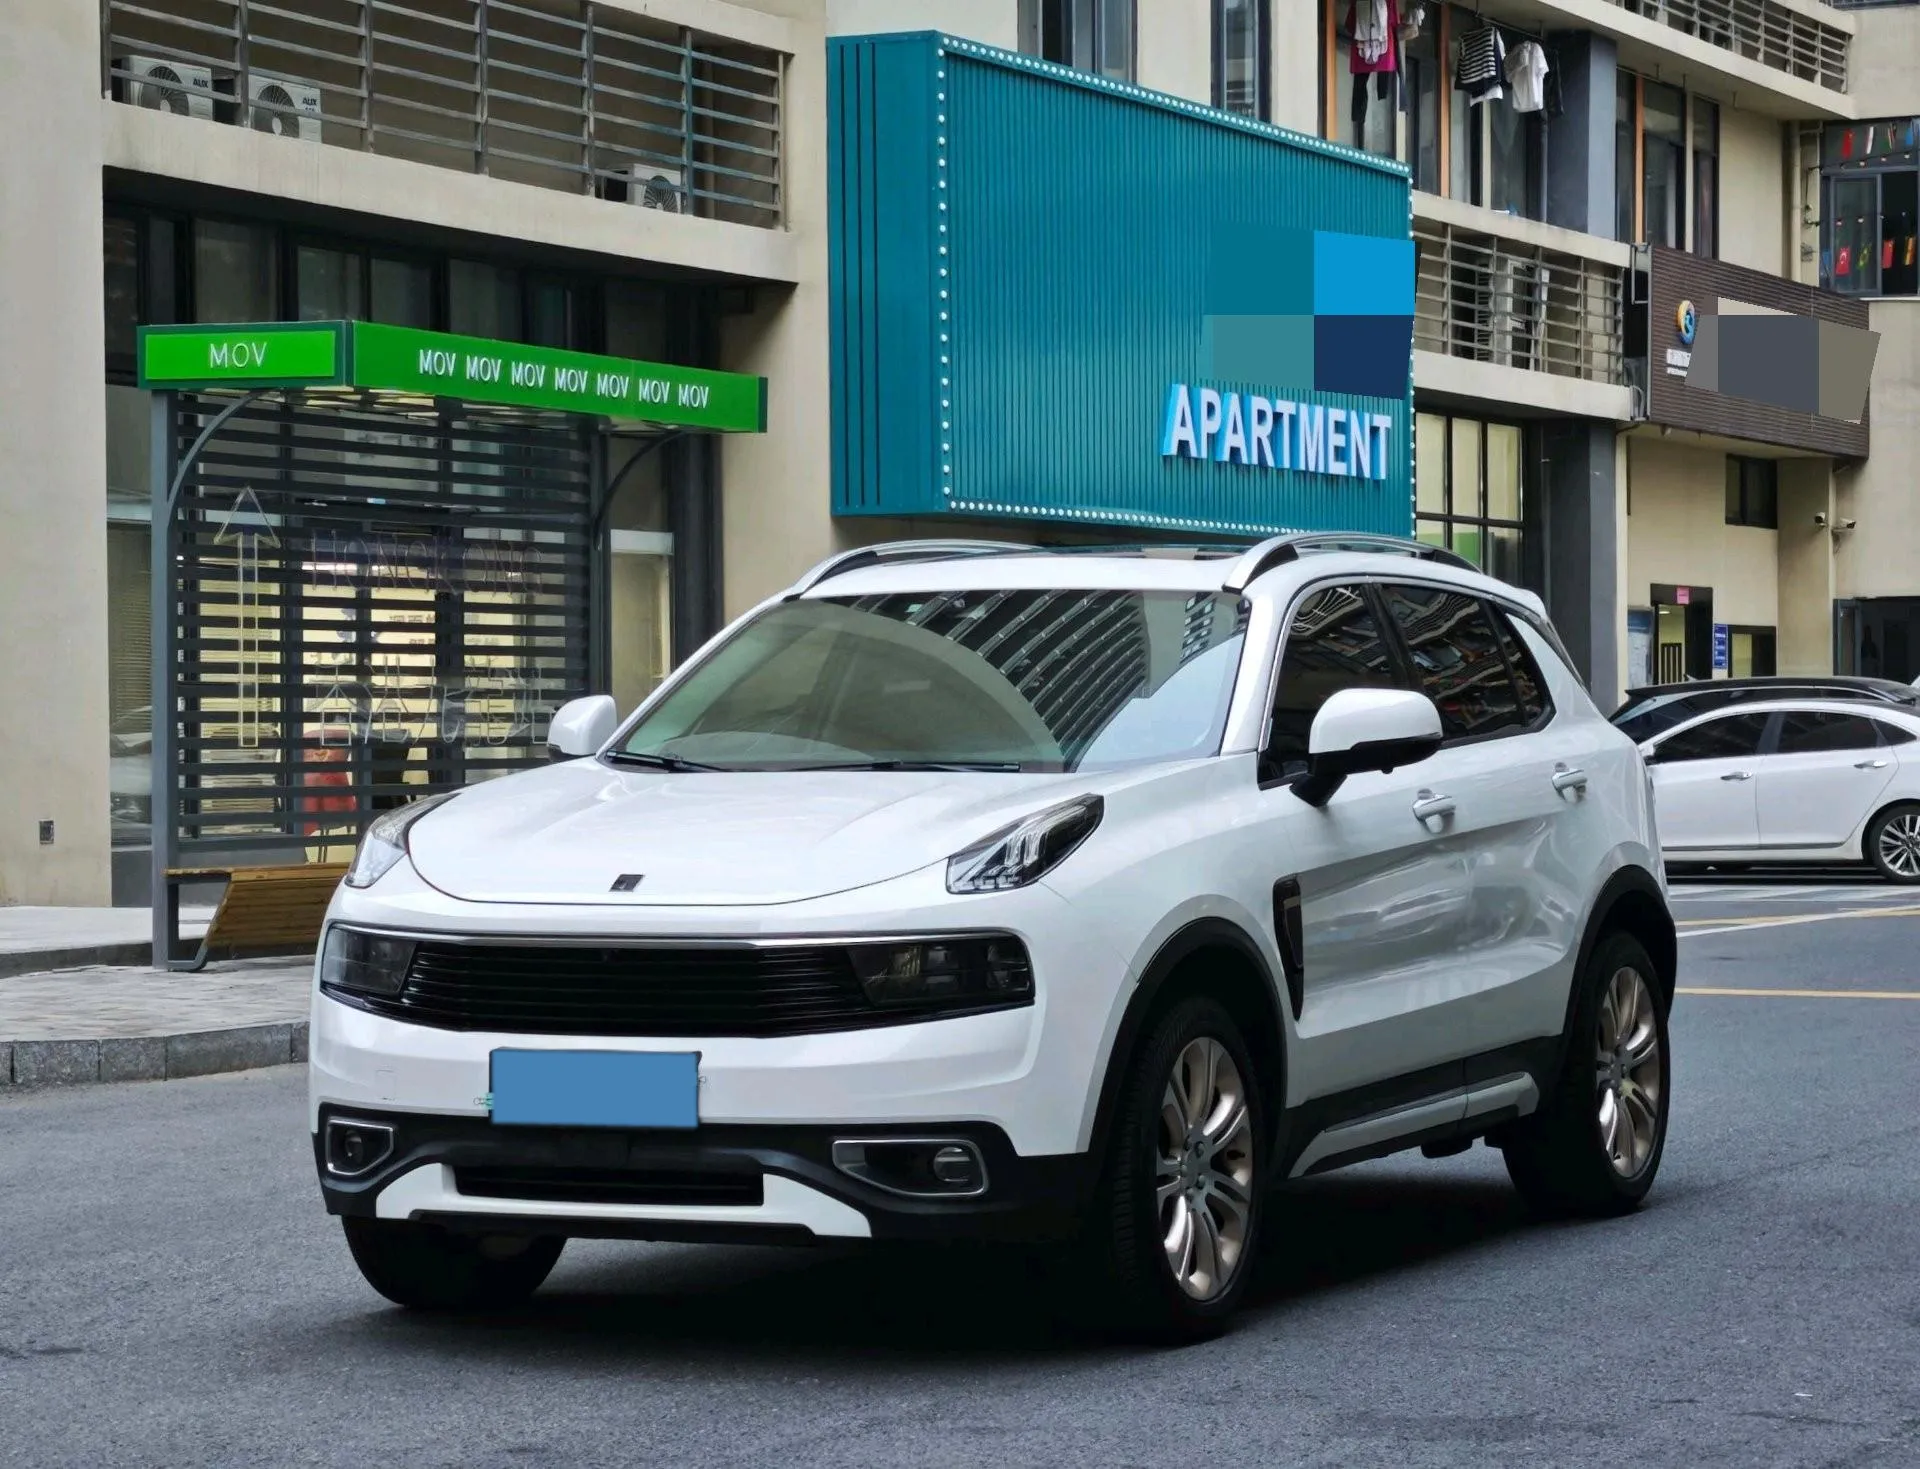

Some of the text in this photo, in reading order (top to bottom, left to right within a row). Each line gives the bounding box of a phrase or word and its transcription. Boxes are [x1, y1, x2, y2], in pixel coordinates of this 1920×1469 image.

[209, 341, 268, 369] MOV
[419, 349, 709, 409] MOV MOV MOV MOV MOV MOV MOV
[1163, 383, 1392, 481] APARTMENT
